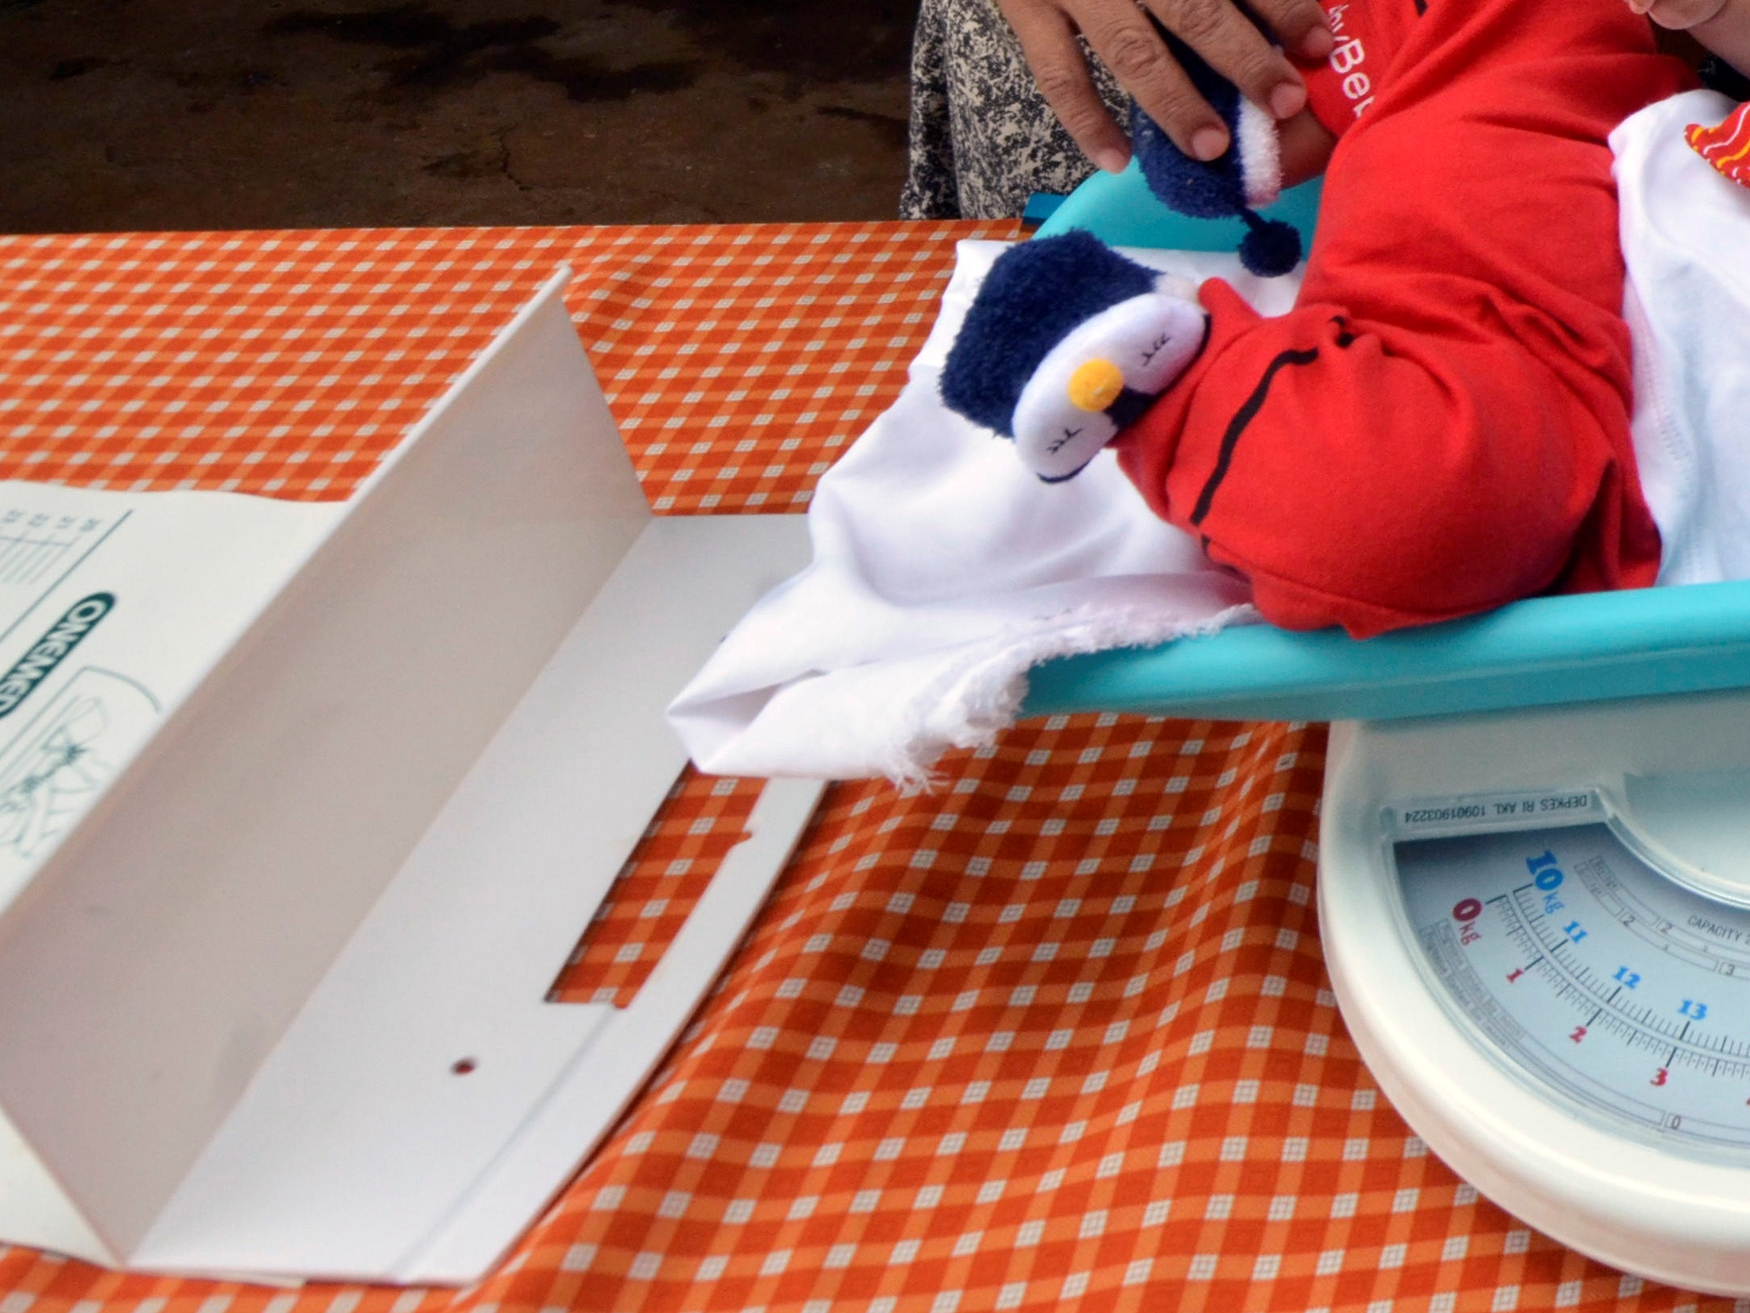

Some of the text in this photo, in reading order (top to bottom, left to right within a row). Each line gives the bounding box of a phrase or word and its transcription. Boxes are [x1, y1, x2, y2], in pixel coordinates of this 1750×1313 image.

[1541, 794, 1588, 812] DEPKES
[1622, 916, 1636, 928] 2
[1725, 962, 1735, 975] 3
[1660, 923, 1673, 935] 2
[1688, 915, 1744, 942] CAPACITY
[1563, 919, 1588, 944] 11
[1612, 965, 1643, 991] 12
[1677, 999, 1709, 1022] 13
[1506, 968, 1524, 984] 1
[1570, 1025, 1588, 1044] 2
[1650, 1068, 1669, 1088] 3
